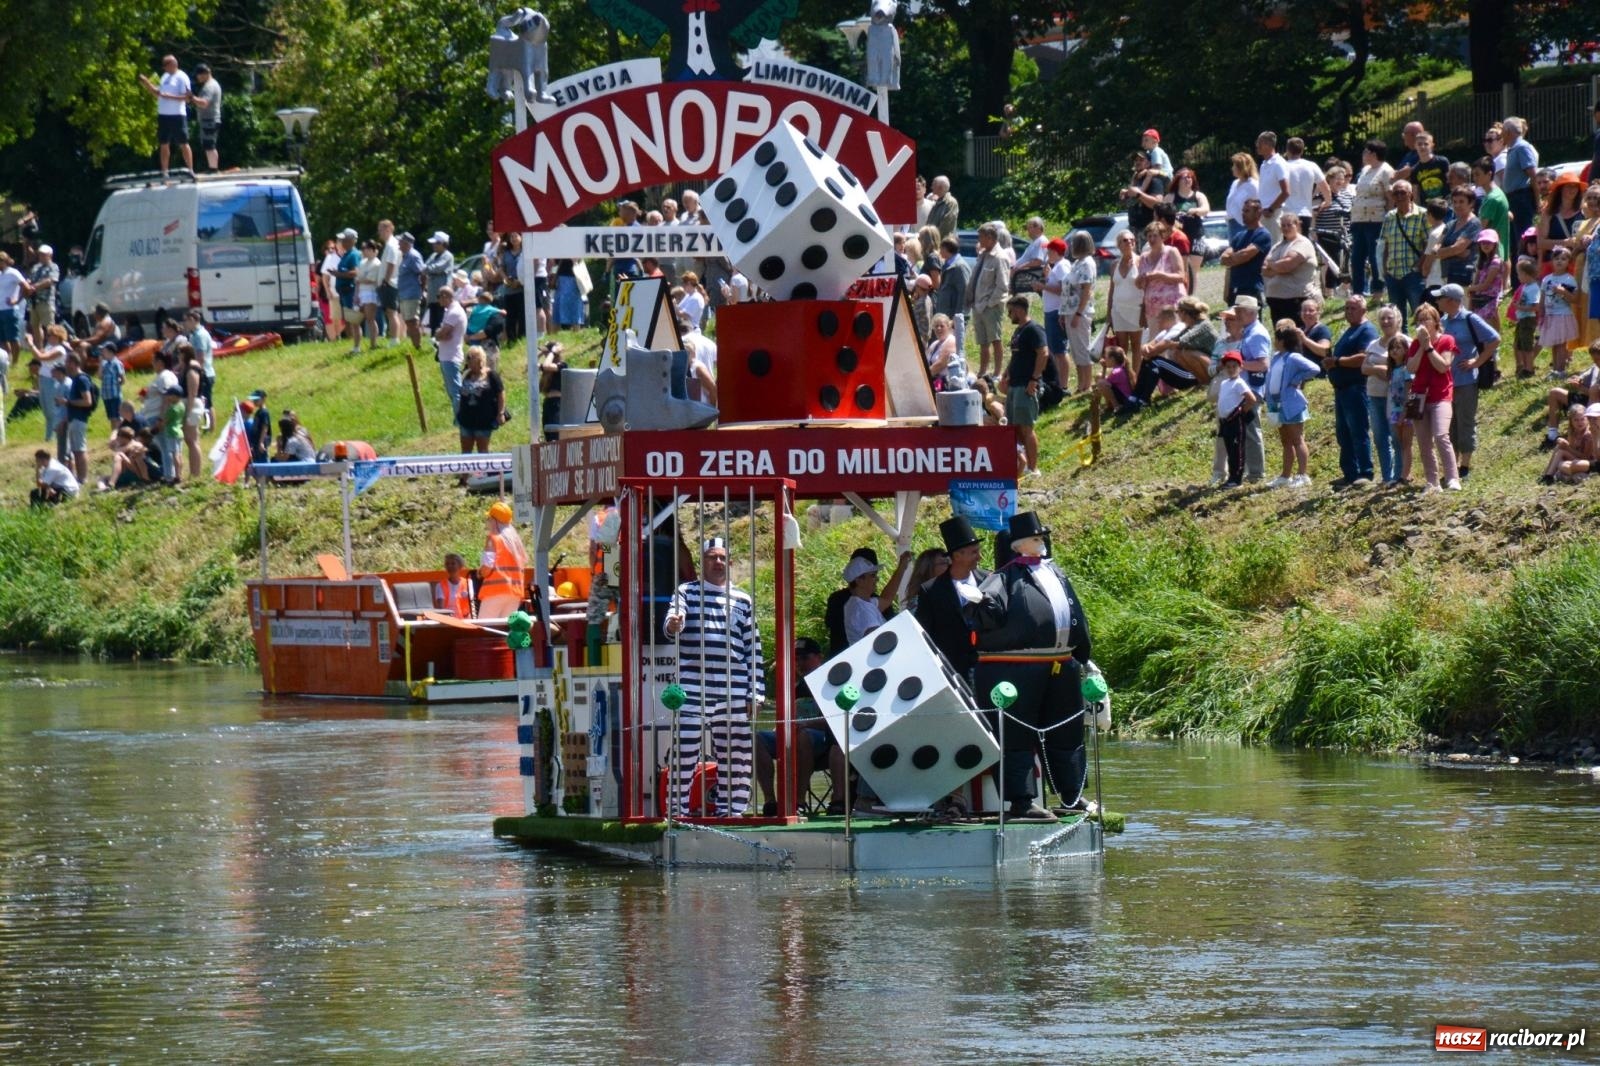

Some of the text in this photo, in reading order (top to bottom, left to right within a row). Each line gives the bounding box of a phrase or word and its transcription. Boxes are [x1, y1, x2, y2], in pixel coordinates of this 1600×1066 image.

[552, 68, 632, 107] EDYCJA
[755, 62, 871, 110] LIMITOWANA
[590, 435, 621, 463] MONOPOLY
[646, 447, 993, 477] OD ZERA DO MILIONERA
[998, 491, 1008, 510] 6
